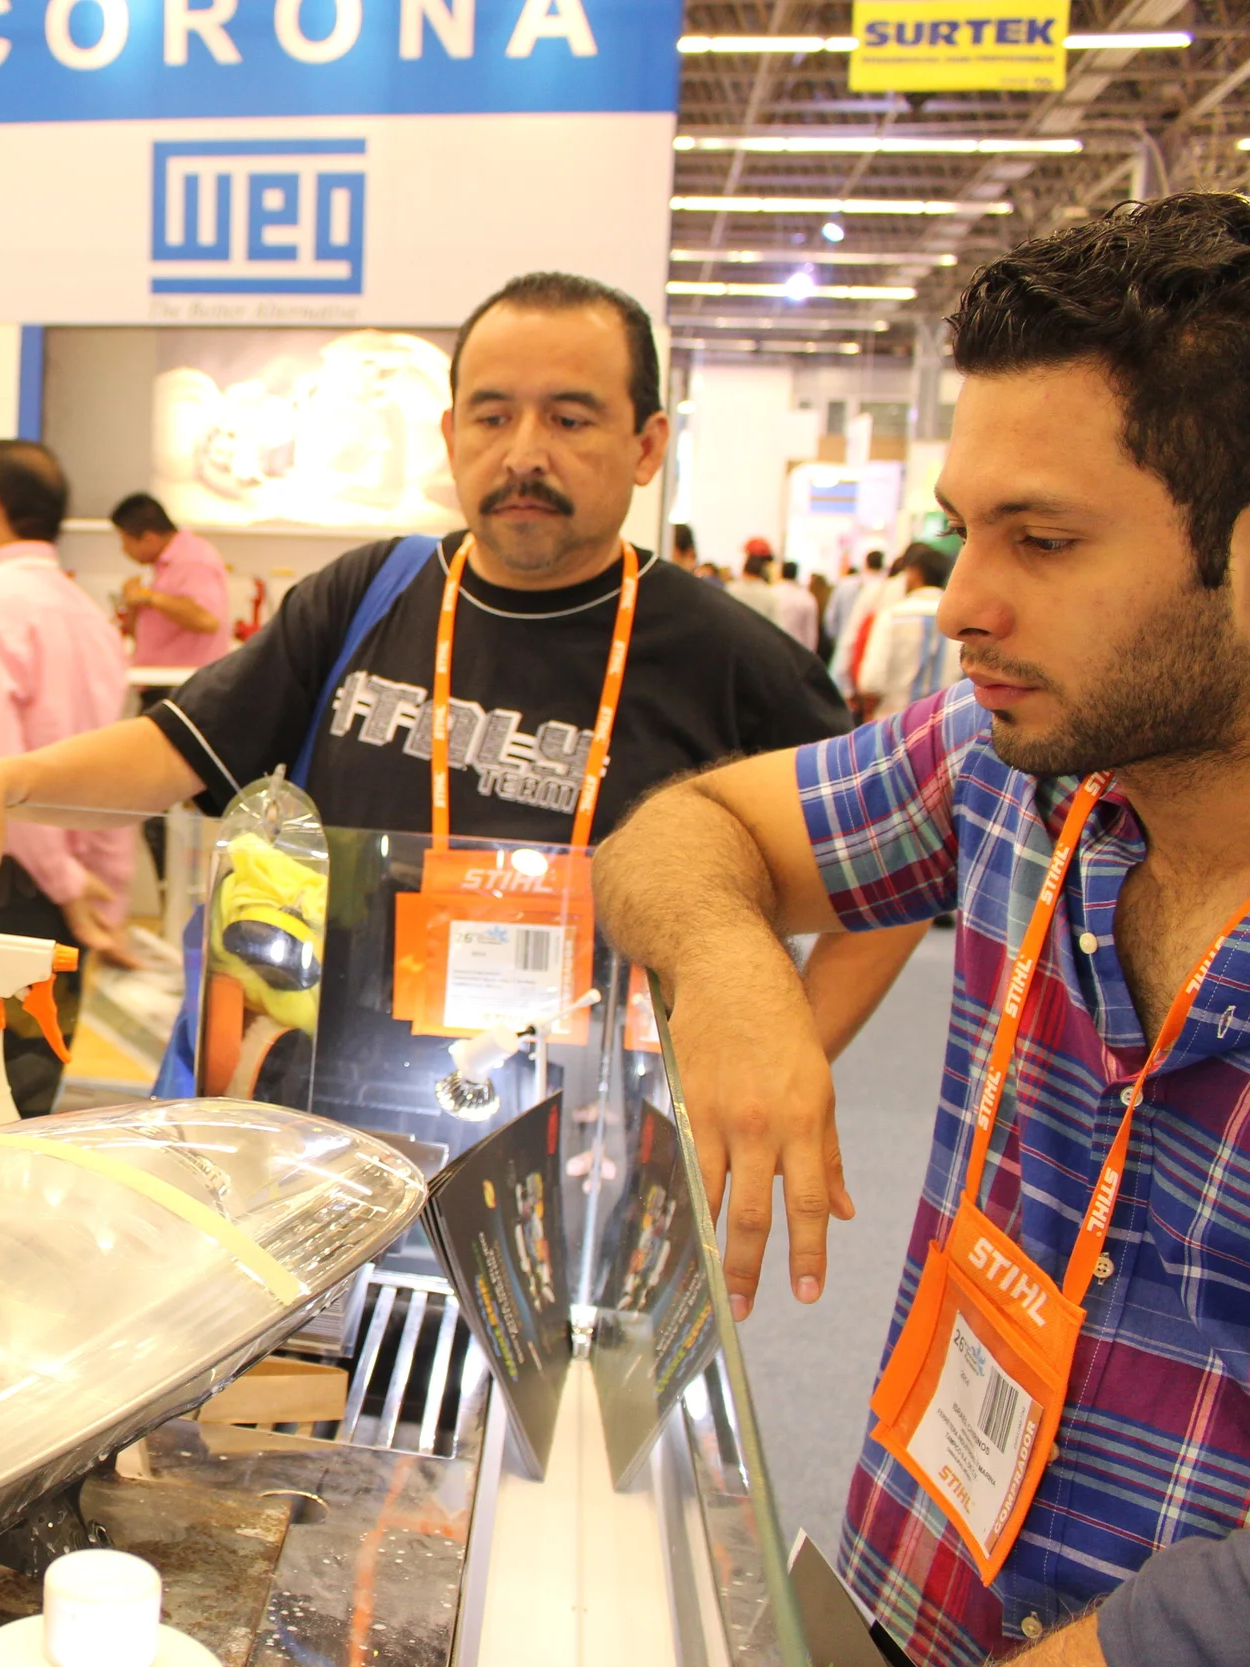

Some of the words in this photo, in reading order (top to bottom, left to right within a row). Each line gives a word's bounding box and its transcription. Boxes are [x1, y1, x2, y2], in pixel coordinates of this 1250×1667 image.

[864, 18, 1056, 47] SURTEK
[461, 868, 554, 893] STIHL
[1040, 846, 1070, 906] STIHL
[1004, 957, 1033, 1019] STIHL
[977, 1070, 1002, 1131] STIHL
[1086, 1166, 1120, 1233] STIHL
[968, 1236, 1049, 1327] STIHL
[954, 1328, 965, 1352] 26
[938, 1465, 972, 1514] STIHL
[994, 1419, 1036, 1535] COMPRADOR
